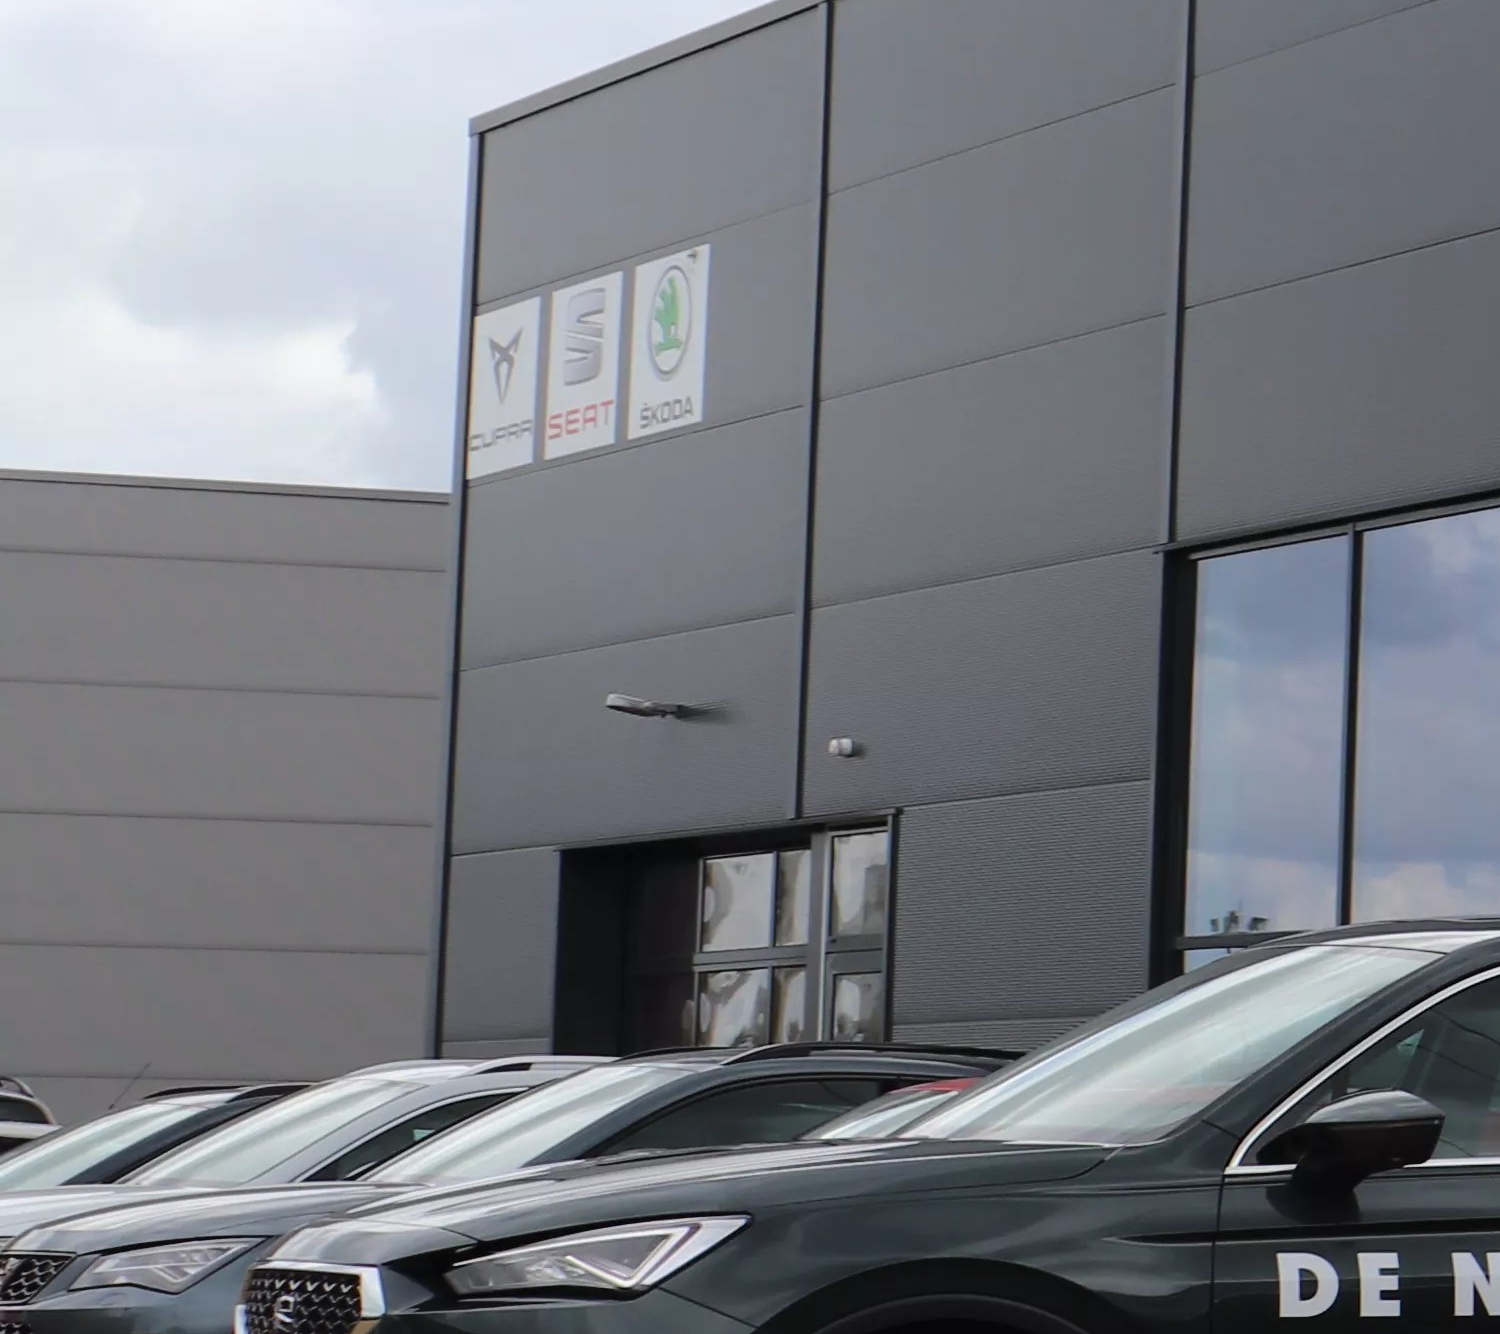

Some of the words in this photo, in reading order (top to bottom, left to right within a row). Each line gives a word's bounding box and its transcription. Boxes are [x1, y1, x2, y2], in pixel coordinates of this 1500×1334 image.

[469, 419, 533, 452] CUPRA
[547, 399, 614, 440] SEAT
[1276, 1252, 1401, 1318] DE
